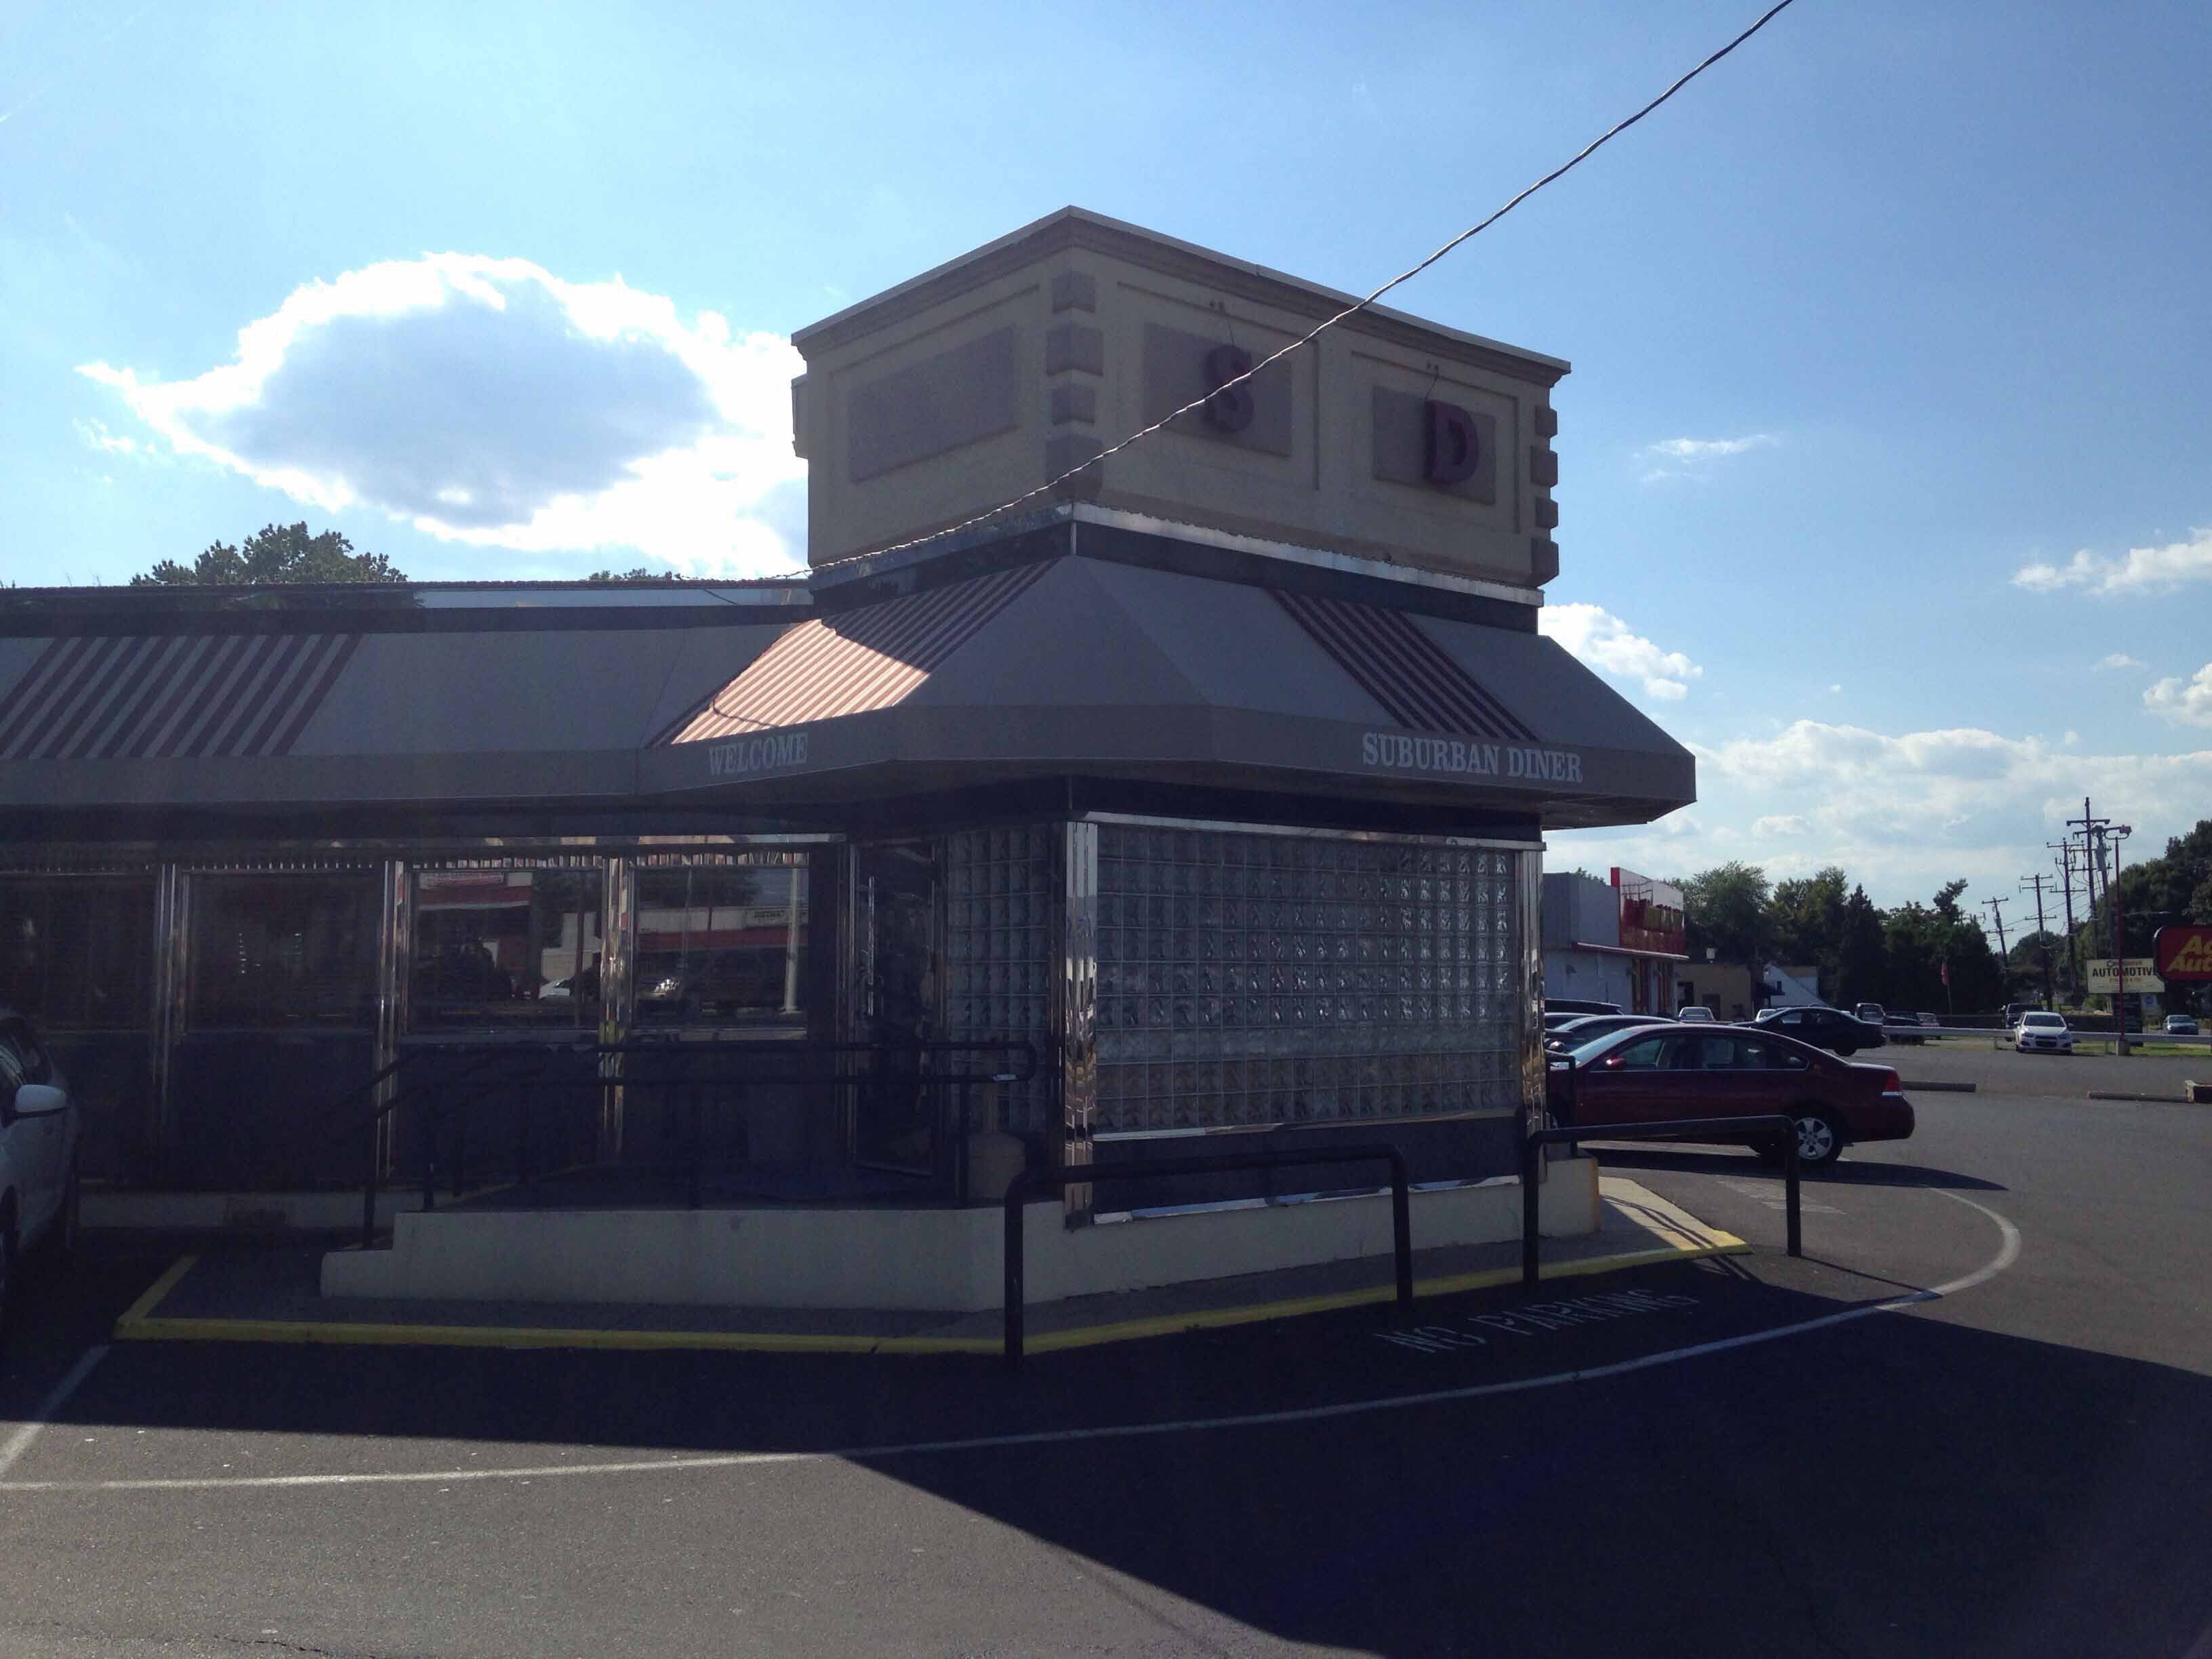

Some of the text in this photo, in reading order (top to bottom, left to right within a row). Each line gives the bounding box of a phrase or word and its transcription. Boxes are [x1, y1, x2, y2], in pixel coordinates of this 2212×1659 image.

[1204, 344, 1254, 433] S
[1424, 399, 1479, 487] D
[708, 731, 808, 776] WELCOME
[1361, 731, 1584, 784] SUBURBAN DINER
[1372, 1288, 1700, 1354] NO PARKING
